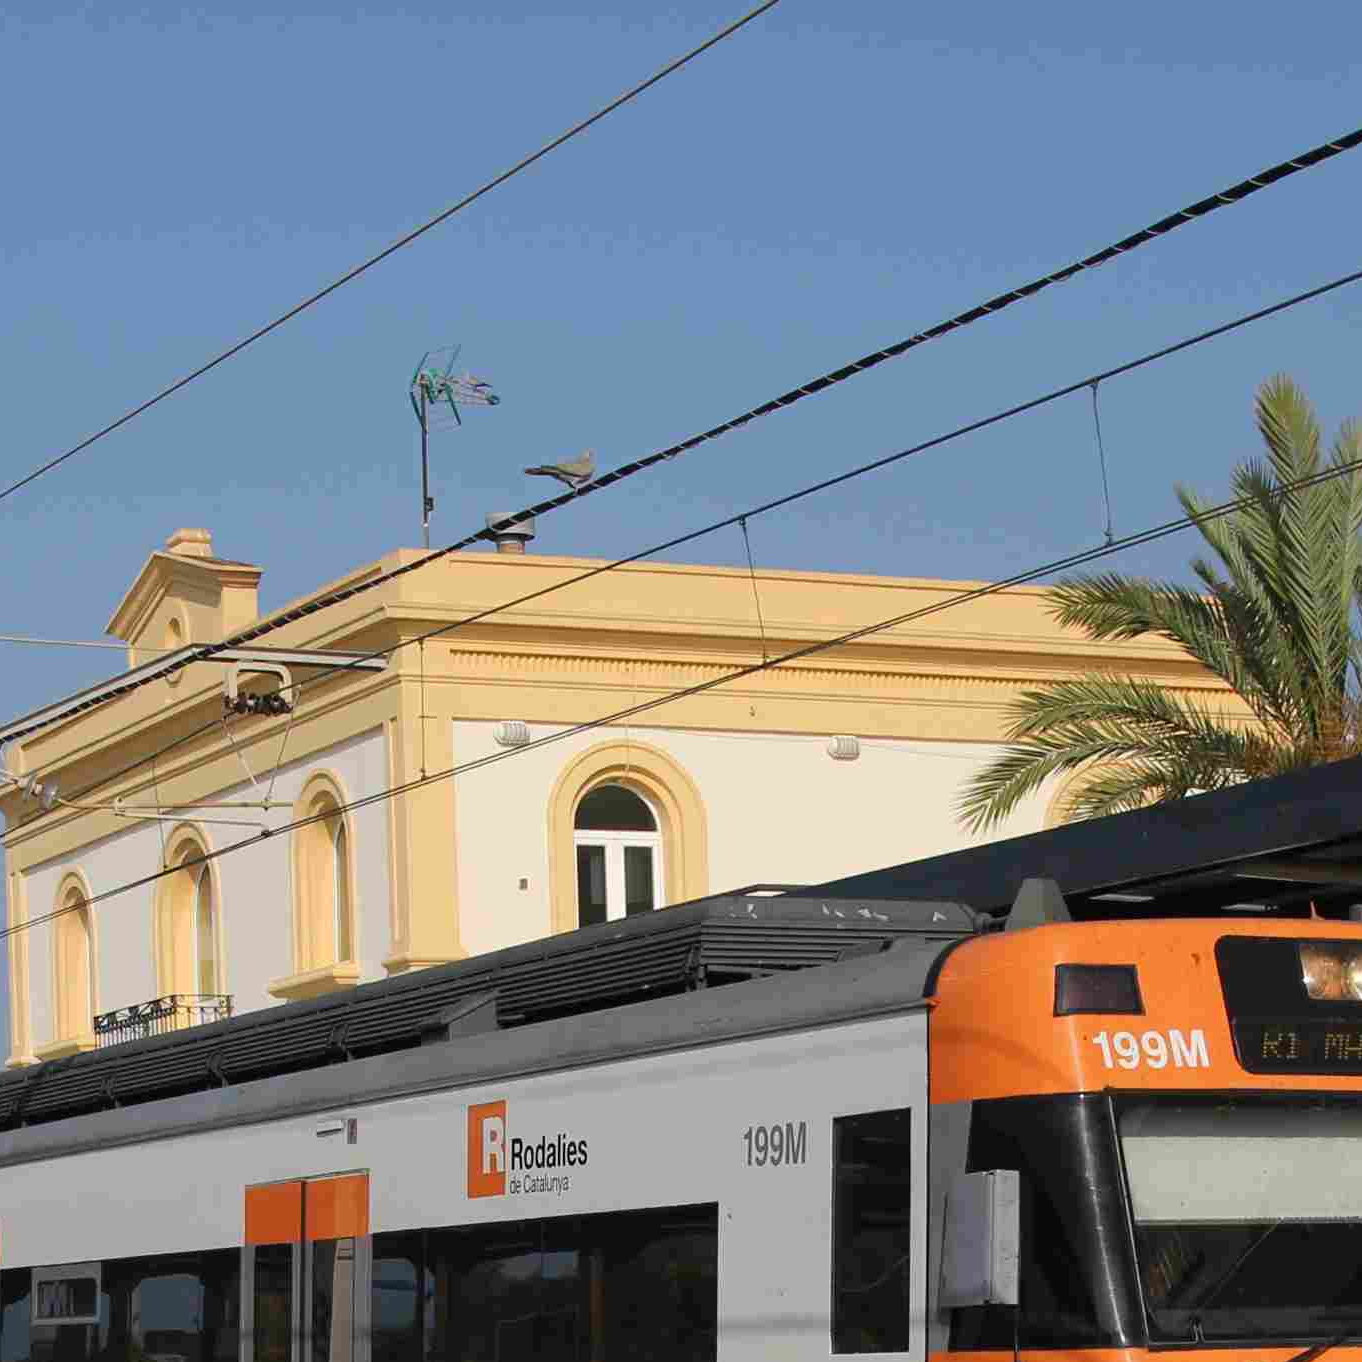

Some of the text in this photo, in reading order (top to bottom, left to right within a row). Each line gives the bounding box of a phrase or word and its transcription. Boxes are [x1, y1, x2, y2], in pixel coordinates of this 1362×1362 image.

[1092, 1029, 1211, 1069] 199M
[483, 1116, 506, 1177] R
[511, 1133, 588, 1170] Rodalies
[743, 1121, 806, 1166] 199M
[509, 1173, 570, 1196] de Catalunya
